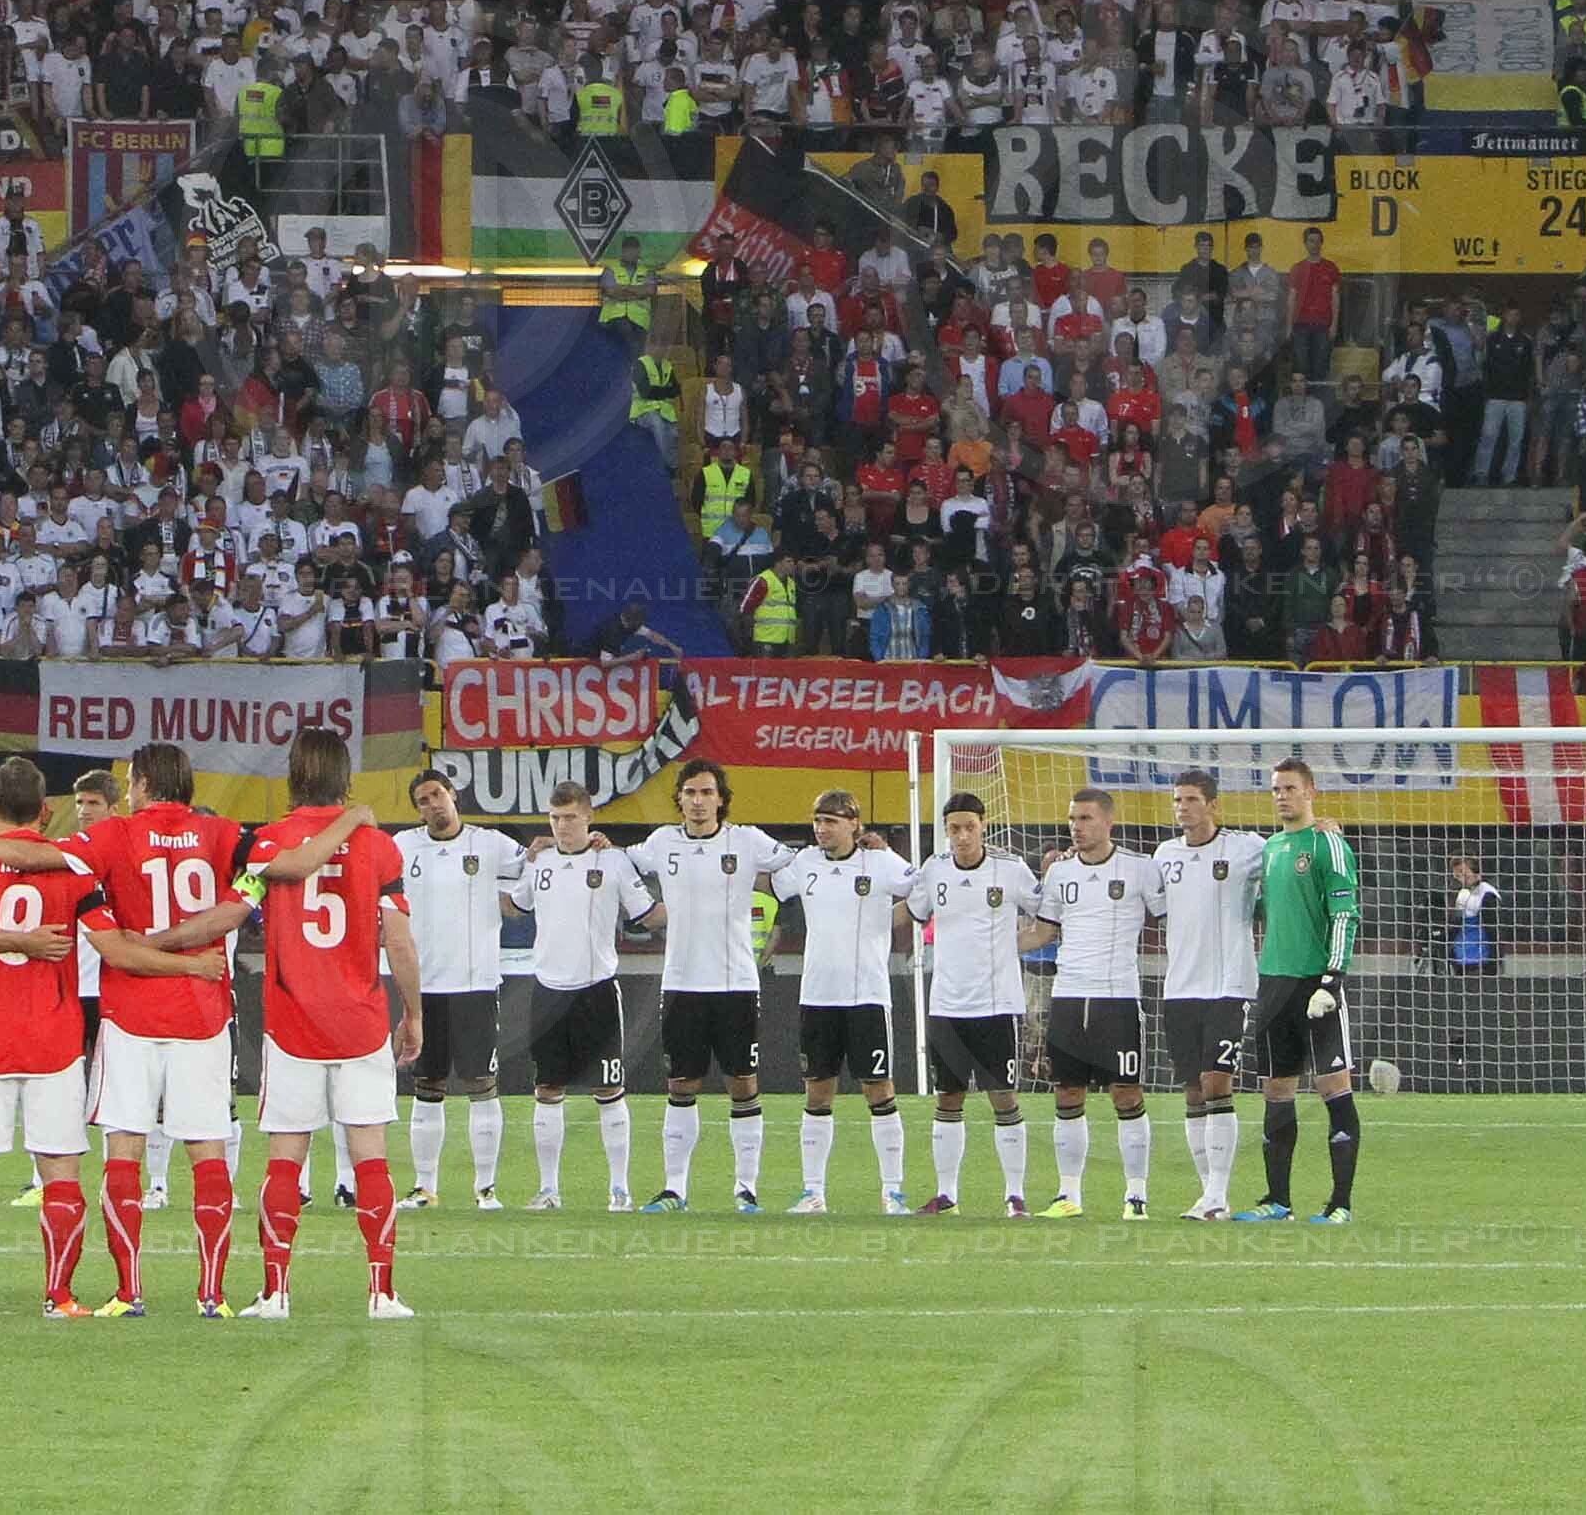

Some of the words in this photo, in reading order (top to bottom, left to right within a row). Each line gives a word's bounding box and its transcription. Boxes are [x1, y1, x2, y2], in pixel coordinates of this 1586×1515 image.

[110, 131, 188, 151] BERLIN
[988, 126, 1336, 224] RECKE
[1350, 169, 1420, 191] BLOCK
[1372, 196, 1399, 238] D
[1453, 238, 1485, 257] WC
[449, 665, 650, 742] CHRISSI
[48, 695, 135, 739] RED
[409, 855, 422, 878] 6
[668, 852, 680, 876] 5
[1162, 860, 1184, 885] 23
[534, 868, 554, 891] 18
[805, 872, 819, 896] 2
[140, 857, 215, 938] 19
[935, 882, 948, 907] 8
[1058, 881, 1080, 904] 10
[302, 864, 348, 950] 5
[749, 1042, 759, 1067] 5
[872, 1049, 885, 1075] 2
[1117, 1050, 1138, 1077] 10
[601, 1059, 622, 1085] 18
[1006, 1057, 1015, 1084] 8
